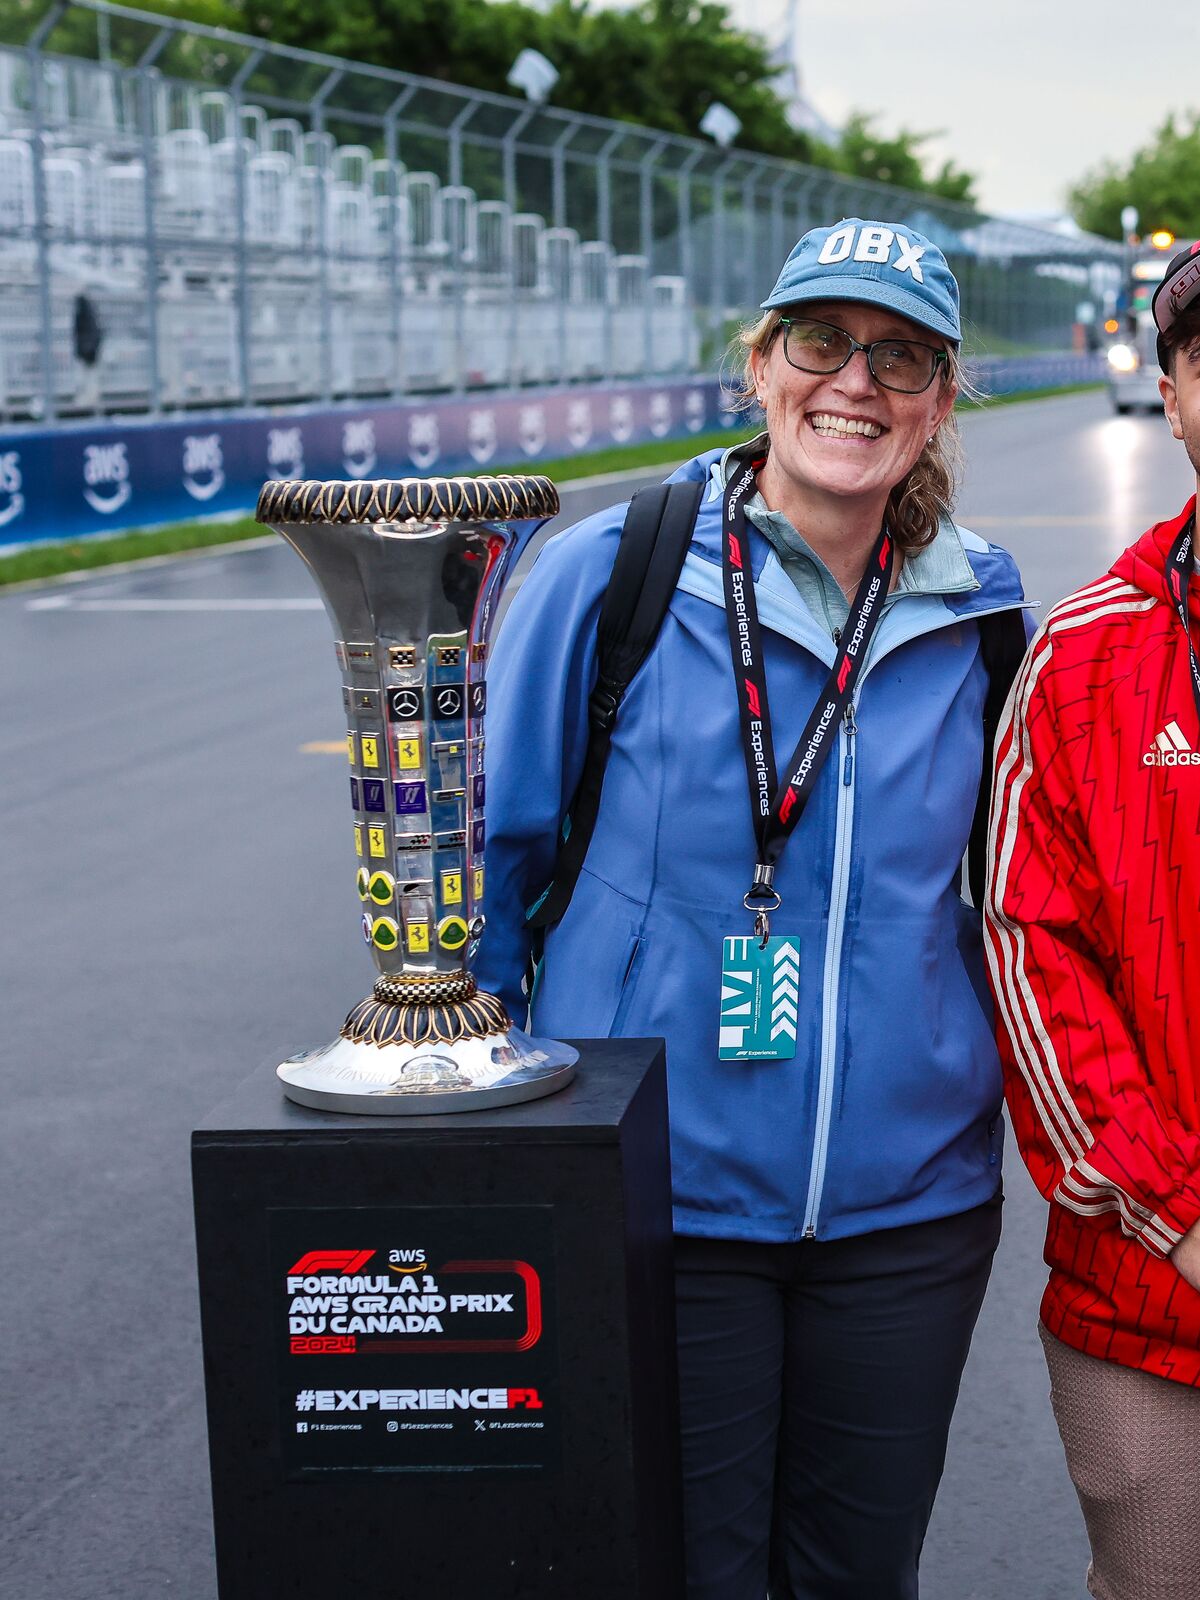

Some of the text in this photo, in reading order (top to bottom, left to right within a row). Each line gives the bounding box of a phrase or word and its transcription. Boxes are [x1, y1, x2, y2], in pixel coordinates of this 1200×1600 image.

[817, 225, 925, 284] OBX
[731, 571, 752, 667] Experiences
[847, 577, 882, 656] Experiences
[791, 701, 836, 787] Experiences
[751, 720, 770, 817] Experiences
[388, 1249, 426, 1263] aws
[287, 1275, 438, 1294] FORMULA 1
[288, 1294, 514, 1314] AWS GRAND PRIX
[289, 1315, 443, 1334] DU CANADA
[290, 1336, 357, 1353] 2024
[295, 1388, 543, 1411] #EXPERIENCEF1
